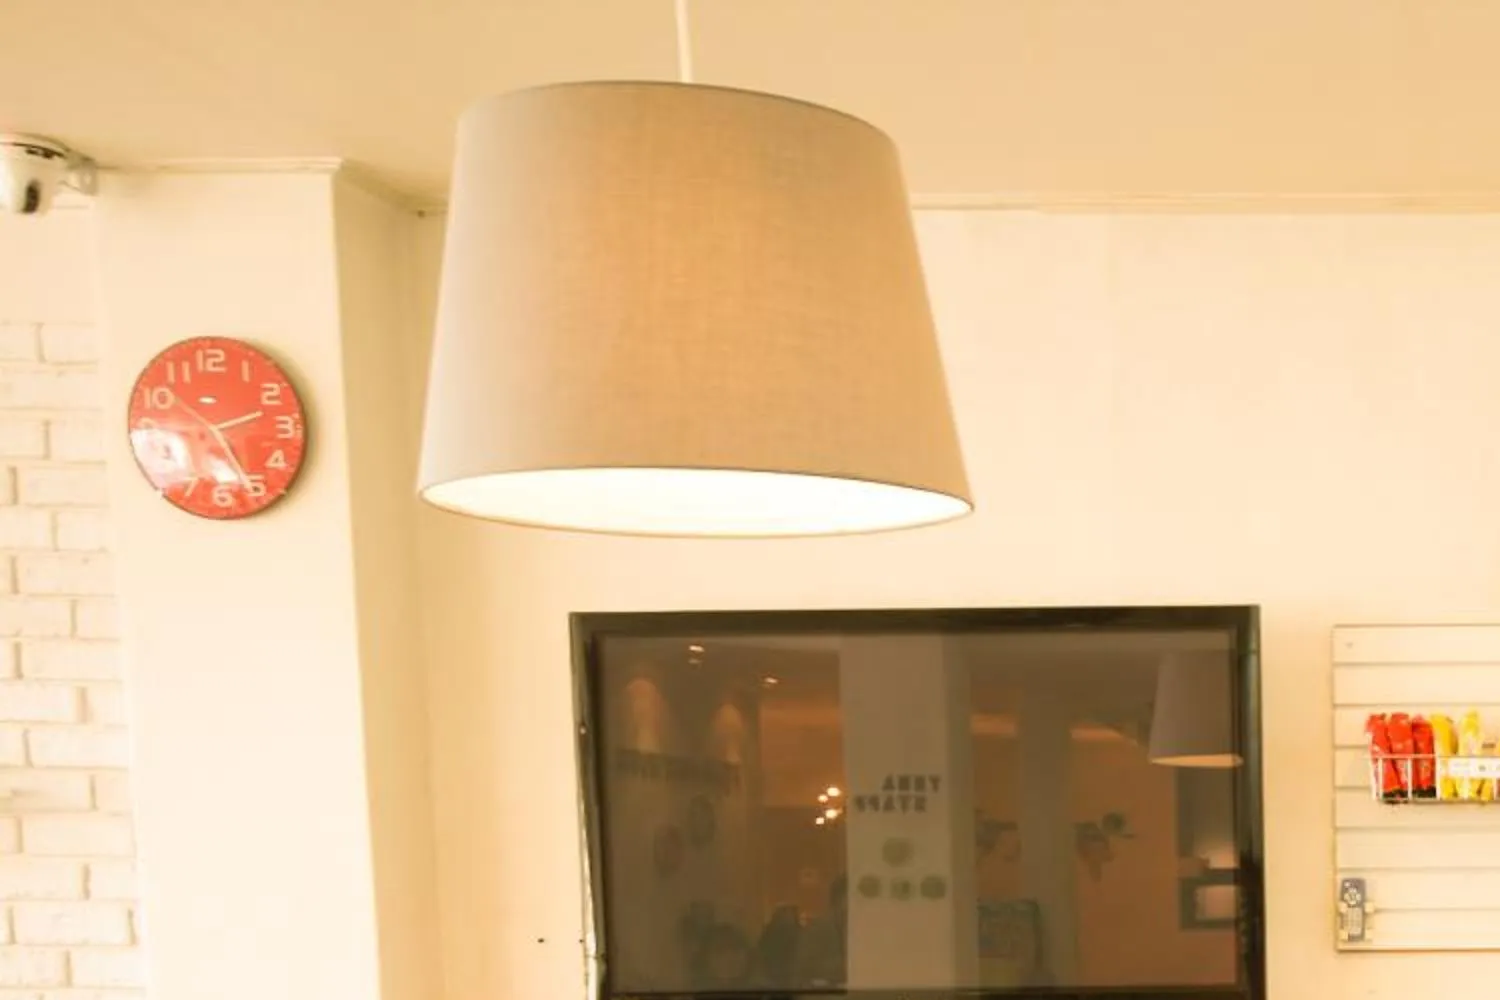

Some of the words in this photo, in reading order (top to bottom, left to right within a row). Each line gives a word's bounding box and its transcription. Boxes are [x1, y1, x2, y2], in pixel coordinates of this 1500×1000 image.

[166, 361, 192, 384] 11
[196, 348, 227, 373] 12
[241, 361, 251, 383] 1
[143, 387, 176, 411] 10
[260, 383, 284, 406] 2
[274, 415, 296, 439] 3
[265, 449, 287, 469] 4
[211, 484, 235, 508] 6
[246, 474, 267, 498] 5
